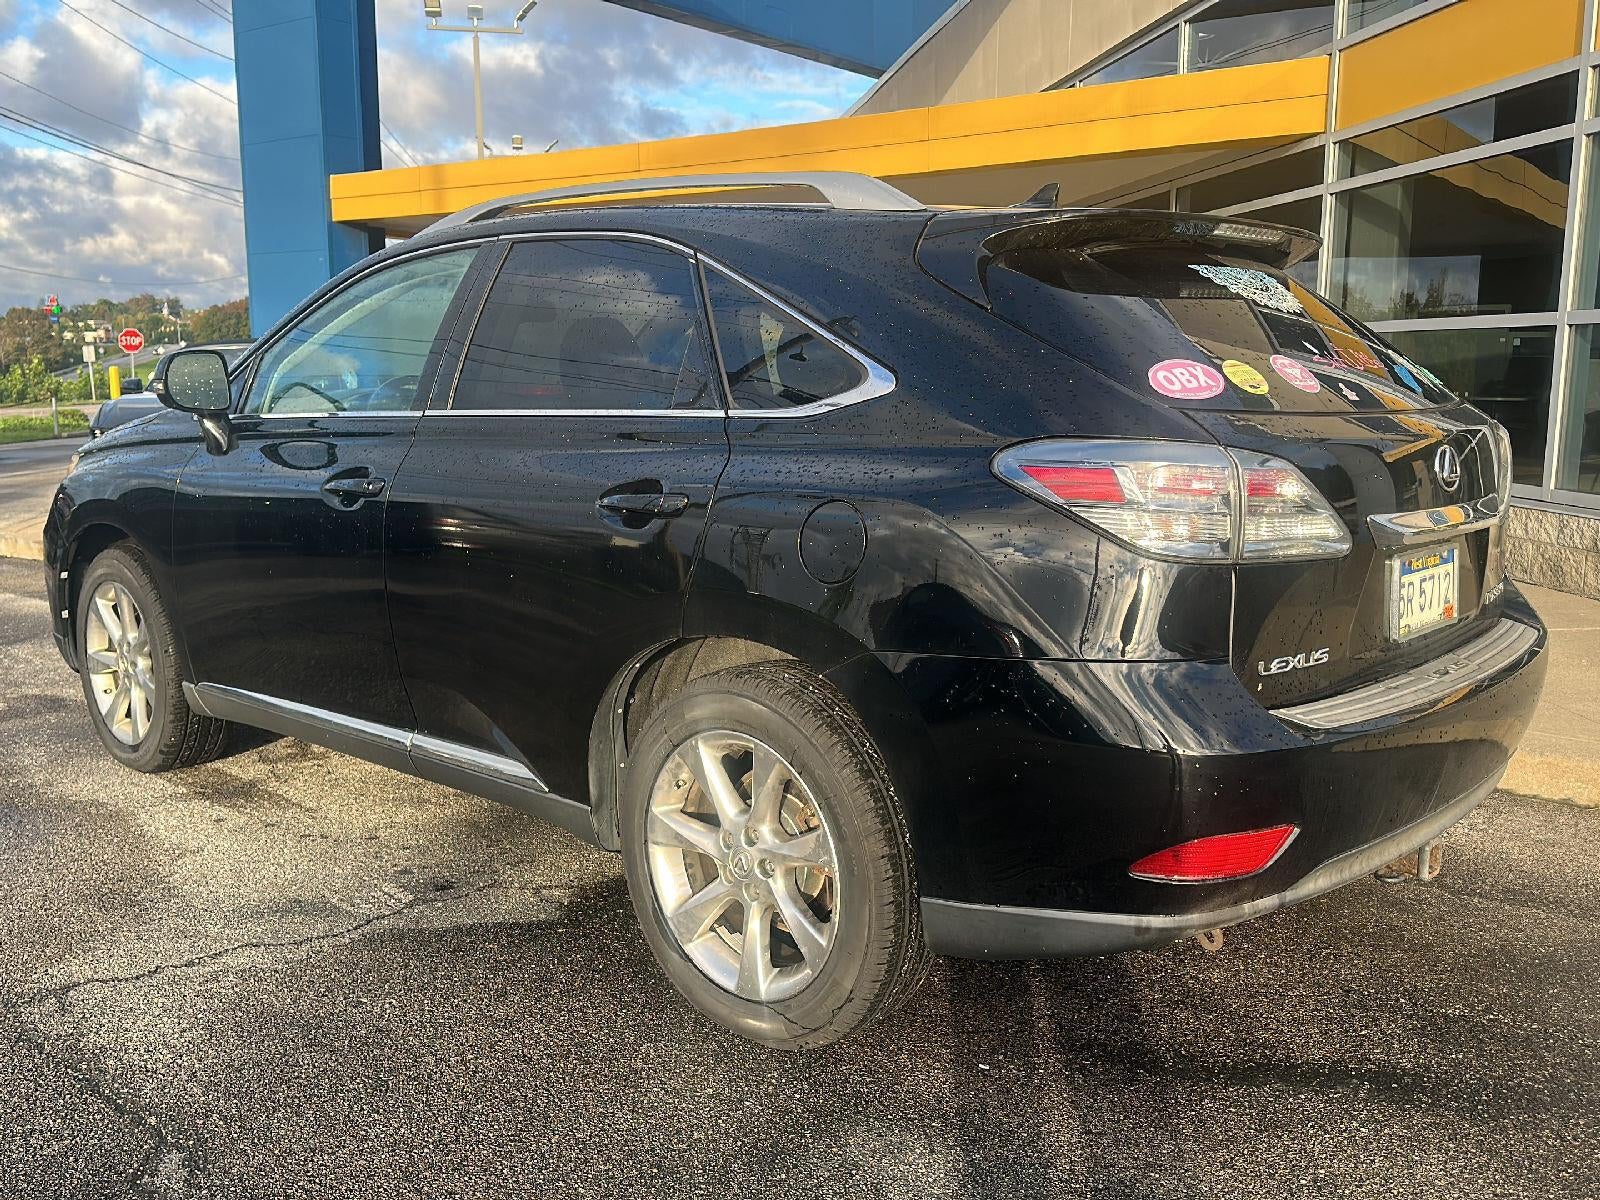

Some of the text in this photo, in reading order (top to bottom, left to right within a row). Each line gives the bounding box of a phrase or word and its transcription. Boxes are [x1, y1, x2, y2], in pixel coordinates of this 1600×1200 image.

[121, 336, 142, 346] STOP
[1156, 366, 1216, 391] OBX
[1419, 570, 1451, 613] 5712
[1257, 647, 1330, 676] LEXUS
